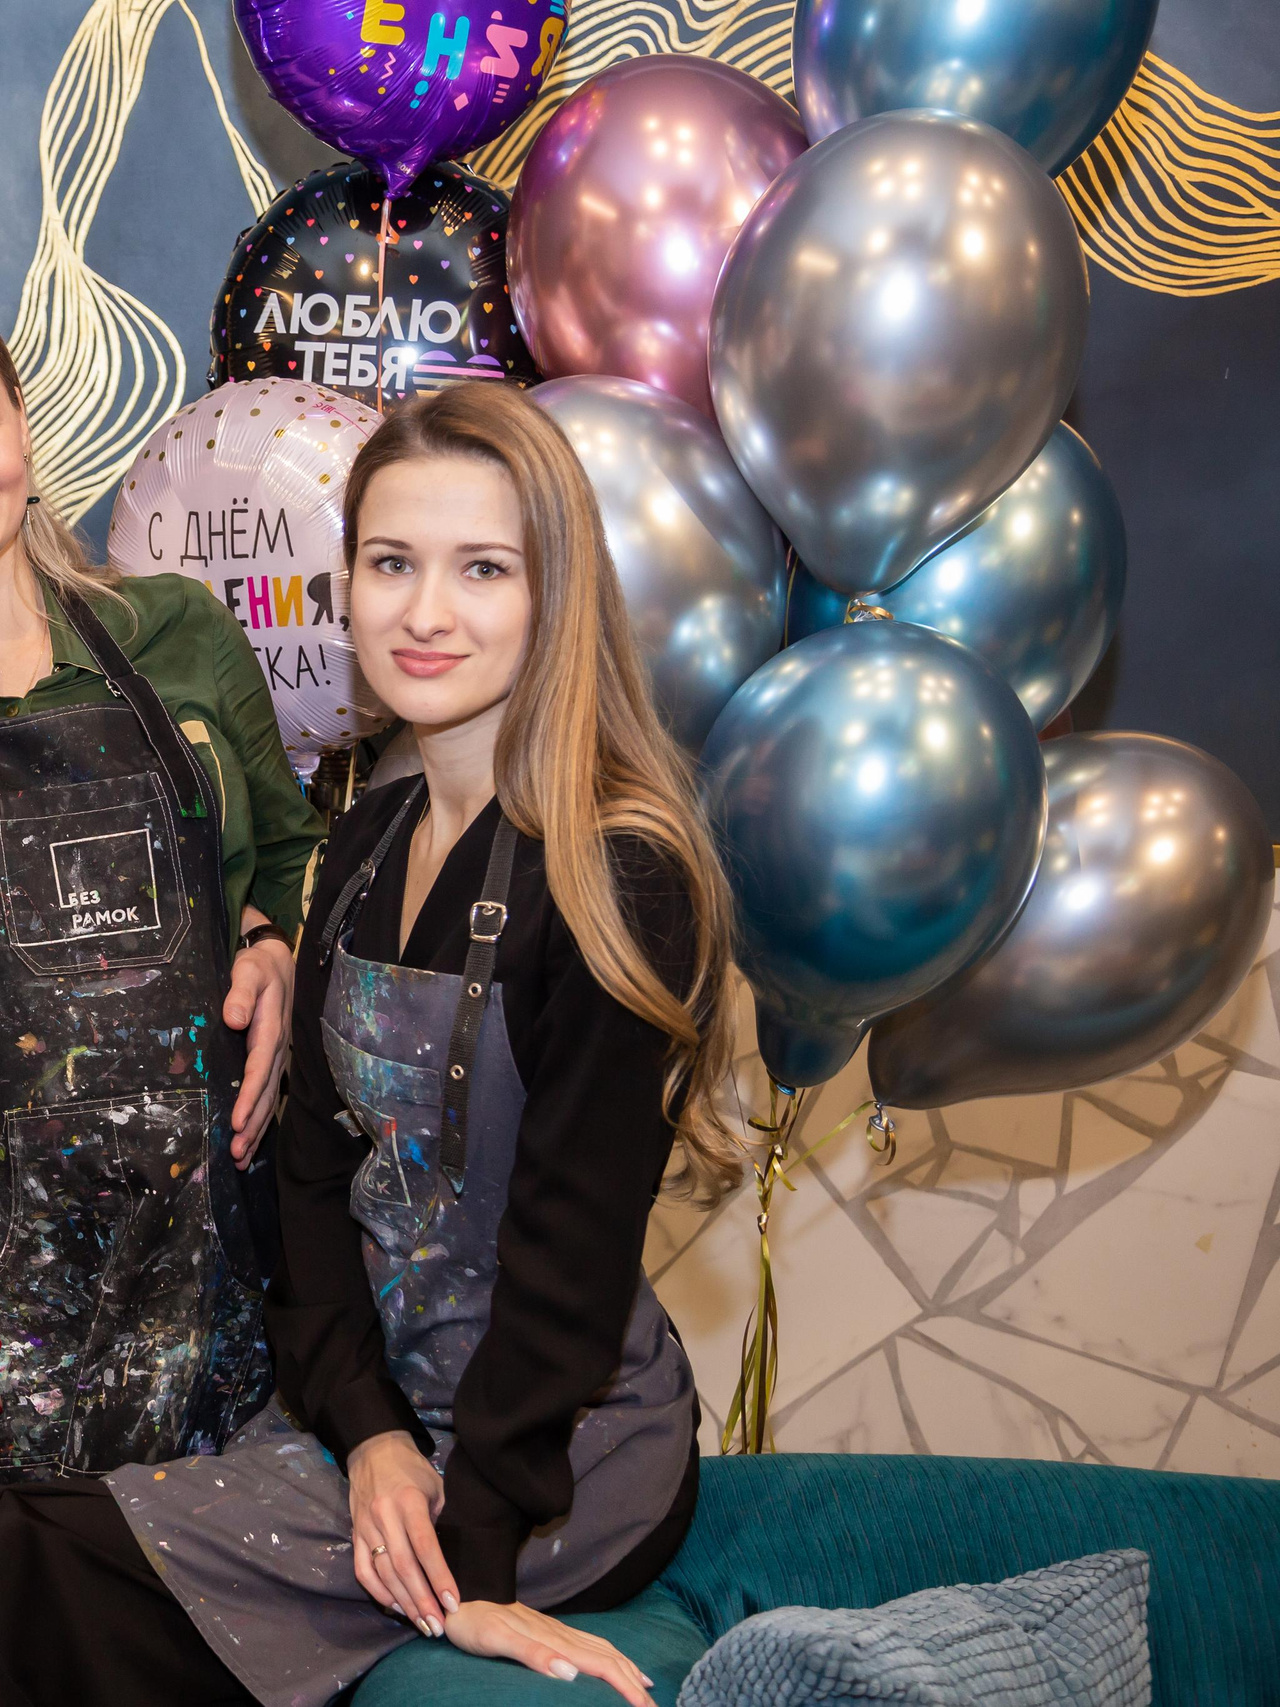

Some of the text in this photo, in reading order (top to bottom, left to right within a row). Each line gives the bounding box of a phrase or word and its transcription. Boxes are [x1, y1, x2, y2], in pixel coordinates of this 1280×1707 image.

[253, 292, 462, 344] ЛЮБЛЮ
[294, 340, 408, 391] ТЕБЯ
[148, 497, 295, 568] С ДНЁМ
[206, 571, 351, 632] ЕНИЯ,
[68, 890, 100, 906] БЕЗ
[72, 906, 139, 929] РАМОК
